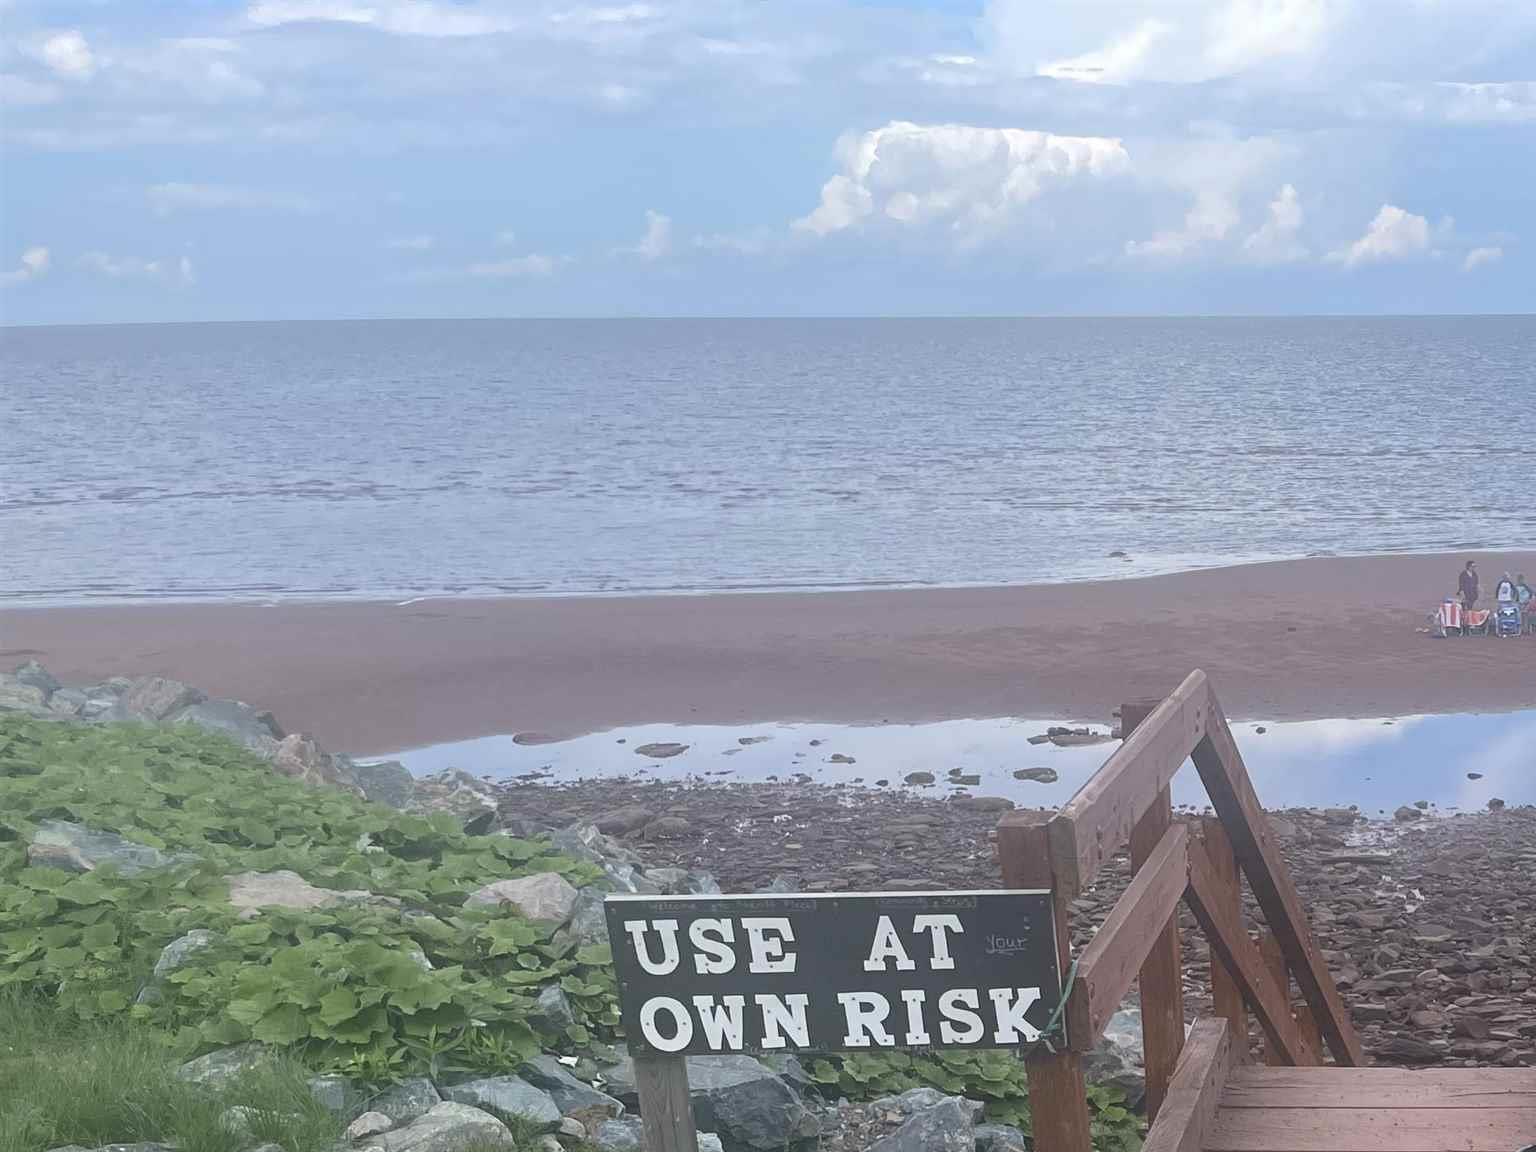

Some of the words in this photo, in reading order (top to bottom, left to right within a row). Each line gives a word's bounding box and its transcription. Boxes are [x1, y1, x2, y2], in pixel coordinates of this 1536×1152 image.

[623, 917, 798, 976] USE
[863, 914, 965, 972] AT
[639, 993, 811, 1053] OWN
[837, 986, 1044, 1047] RISK
